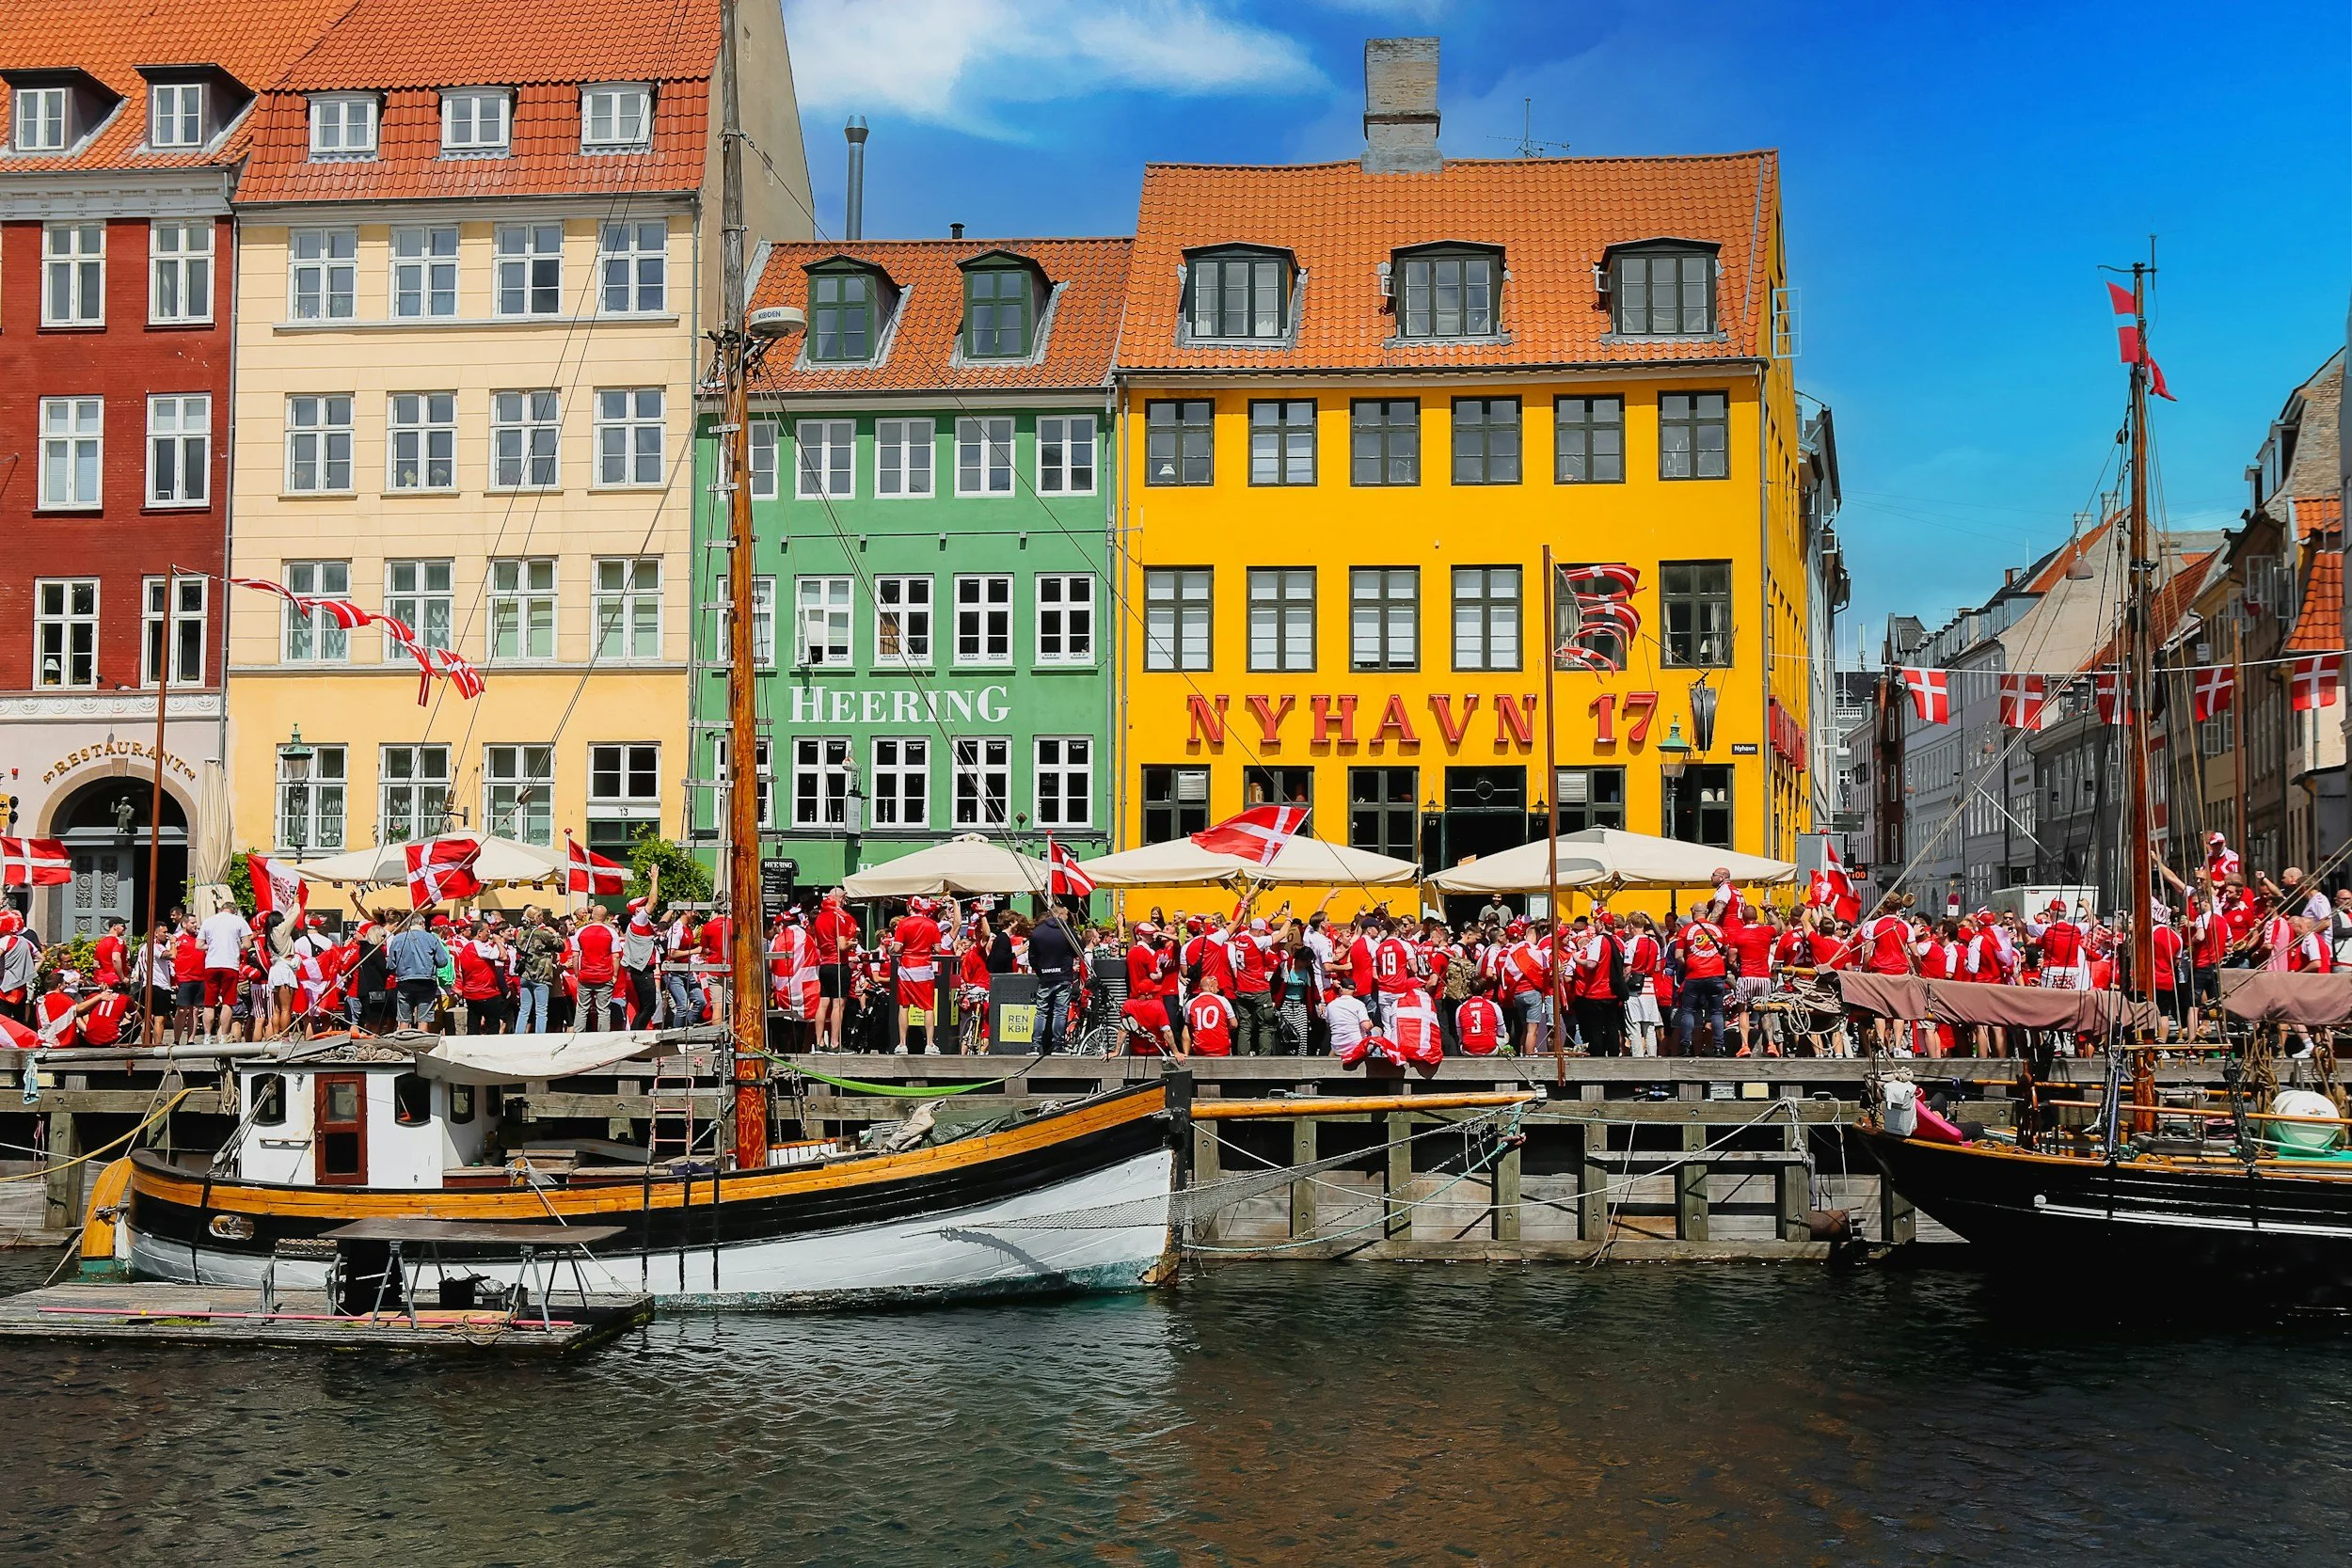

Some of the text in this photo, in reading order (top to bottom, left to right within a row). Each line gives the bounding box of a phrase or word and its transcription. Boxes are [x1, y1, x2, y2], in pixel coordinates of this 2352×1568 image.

[758, 310, 781, 319] KODEN
[787, 685, 1012, 723] HEERING
[1186, 690, 1660, 744] NYHAVN 17
[54, 740, 186, 776] RESTAURANT
[620, 808, 628, 816] 13
[764, 861, 793, 869] HEERING
[1381, 952, 1396, 975] 19
[98, 1000, 114, 1017] 11
[1194, 1005, 1219, 1031] 10
[1470, 1009, 1482, 1034] 3
